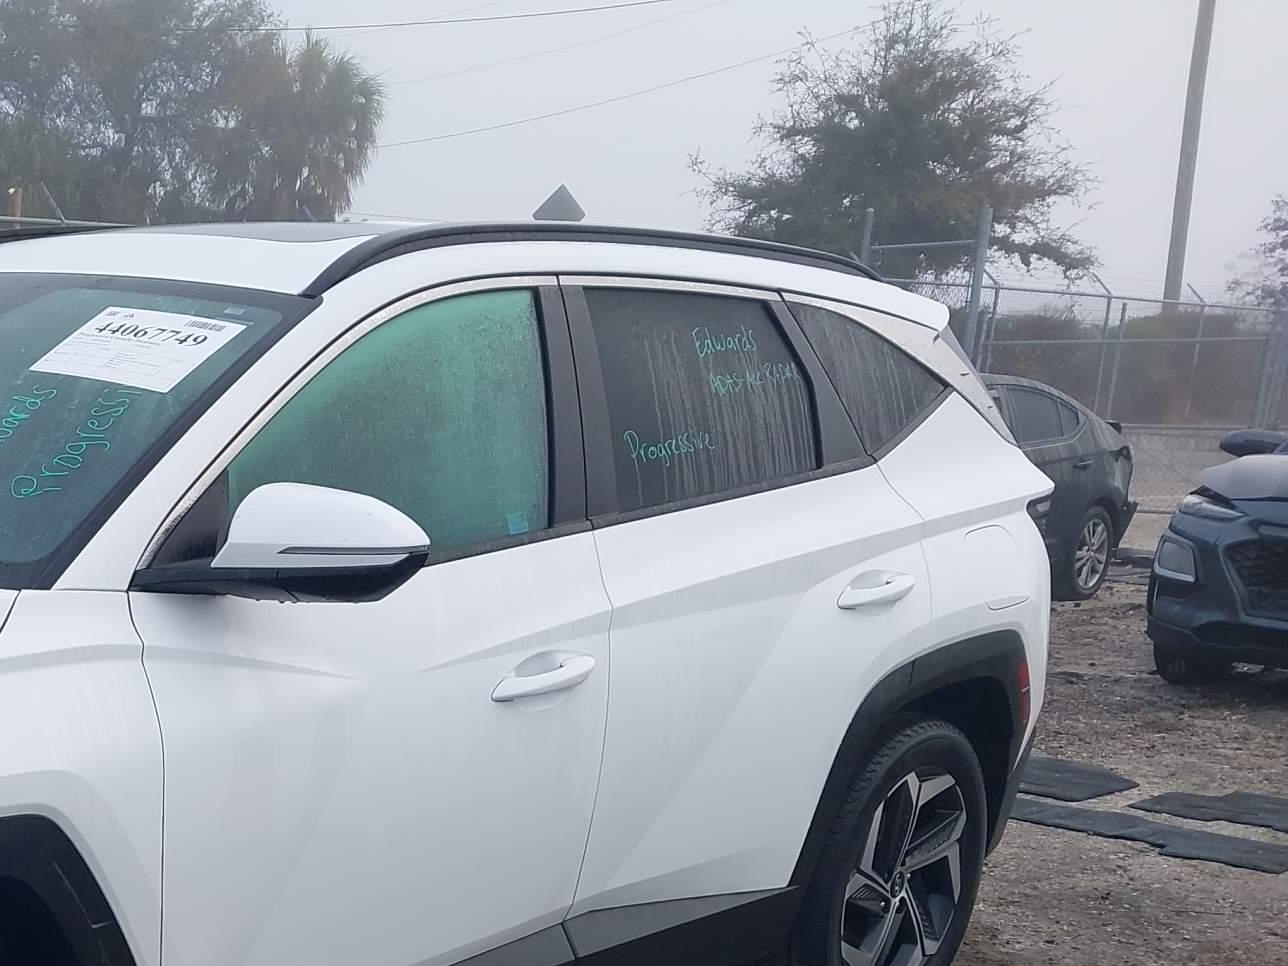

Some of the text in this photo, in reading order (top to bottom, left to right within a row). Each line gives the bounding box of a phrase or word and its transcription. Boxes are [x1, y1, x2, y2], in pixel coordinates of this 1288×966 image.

[94, 321, 209, 347] 44067749
[692, 324, 758, 358] Edwards
[623, 430, 715, 467] Progressive
